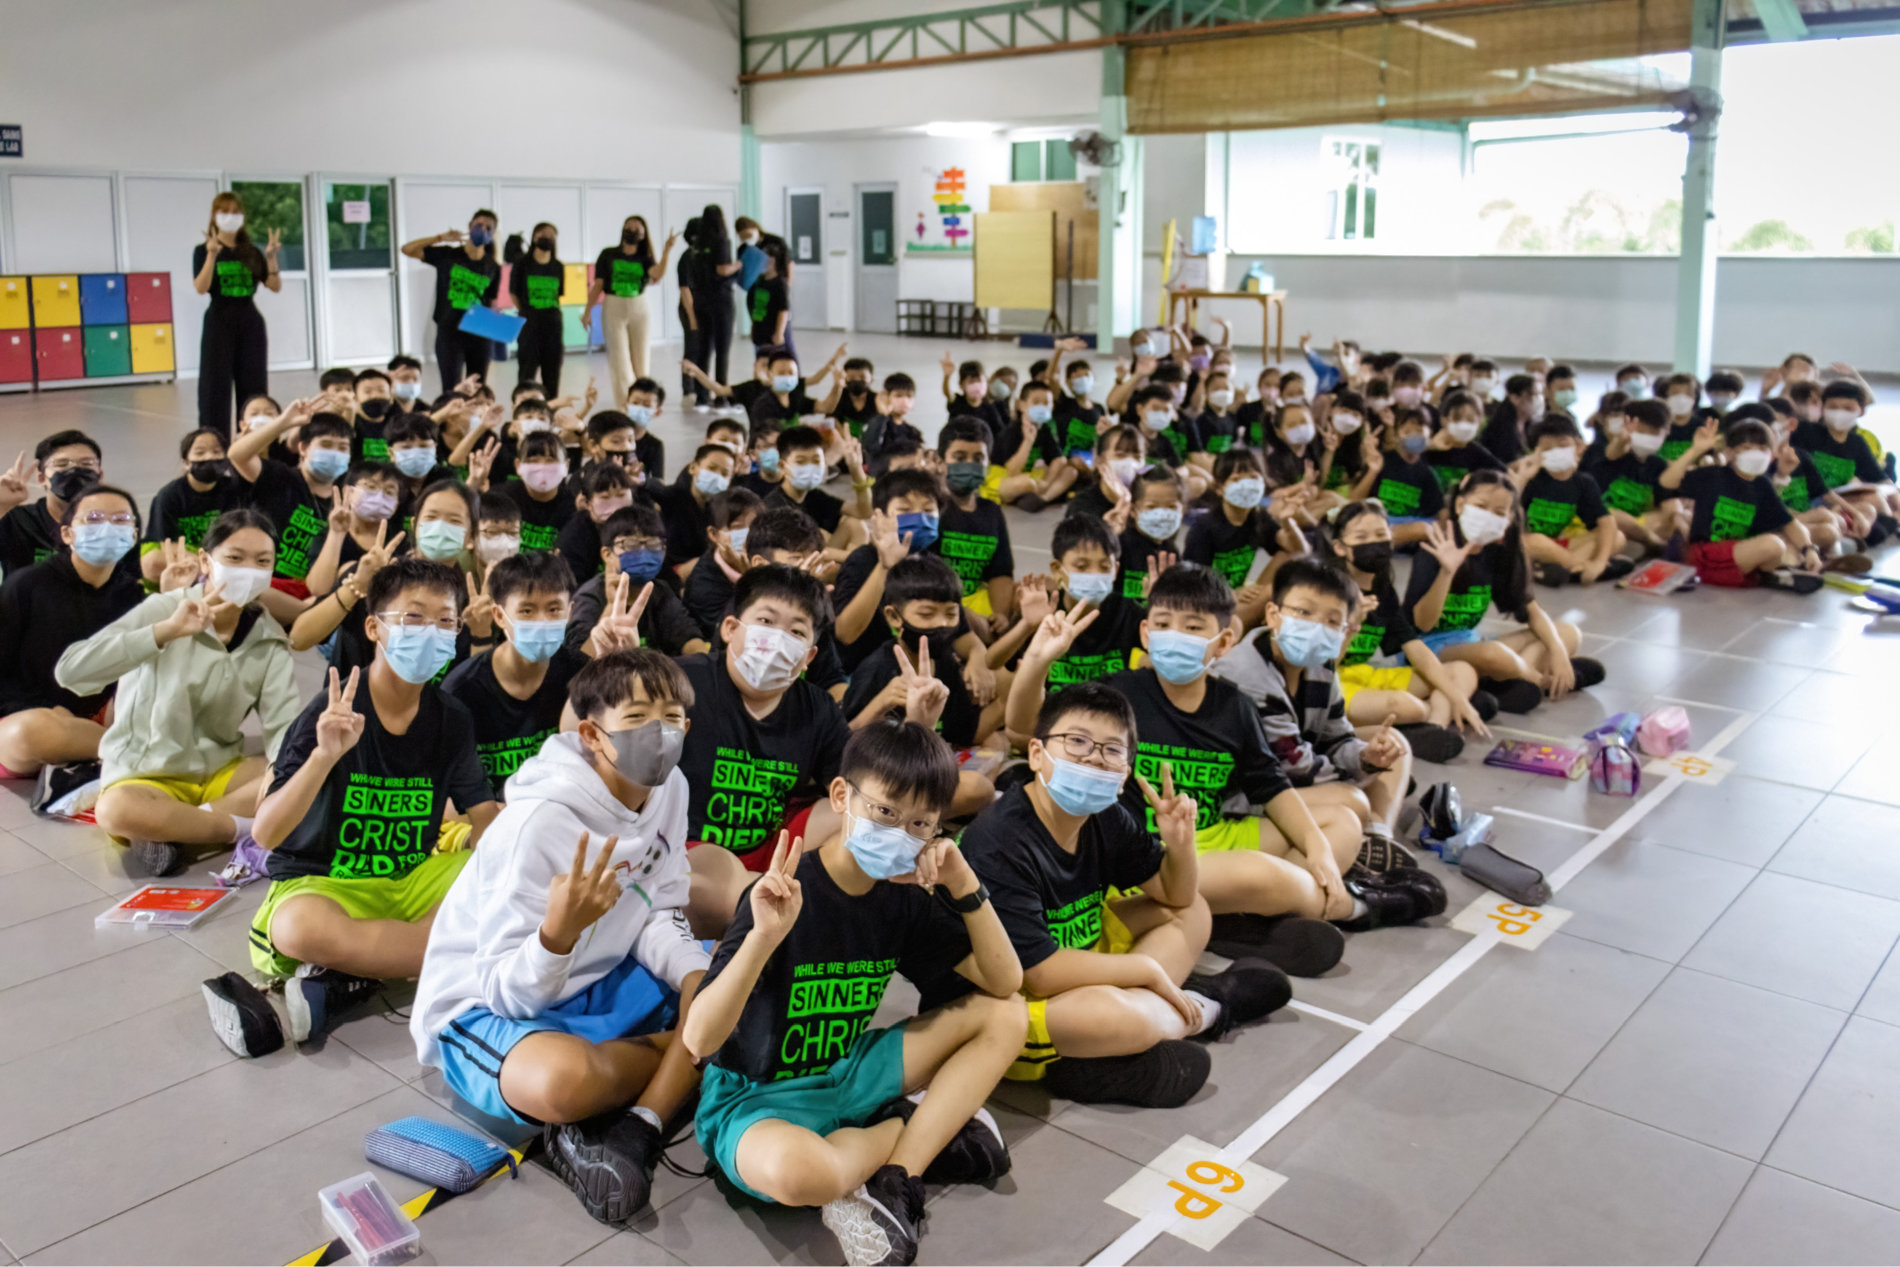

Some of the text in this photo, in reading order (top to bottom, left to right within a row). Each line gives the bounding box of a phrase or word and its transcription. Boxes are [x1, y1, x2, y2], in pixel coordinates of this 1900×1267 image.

[717, 746, 744, 759] WHILE
[1137, 742, 1170, 756] WHILE
[1171, 746, 1187, 758] WE
[407, 777, 433, 787] STILL
[1486, 903, 1544, 935] 5P
[794, 963, 825, 978] WHILE
[827, 961, 845, 974] WE
[847, 960, 875, 974] WERE
[781, 1015, 872, 1064] CHRI
[1167, 1160, 1245, 1220] 6P
